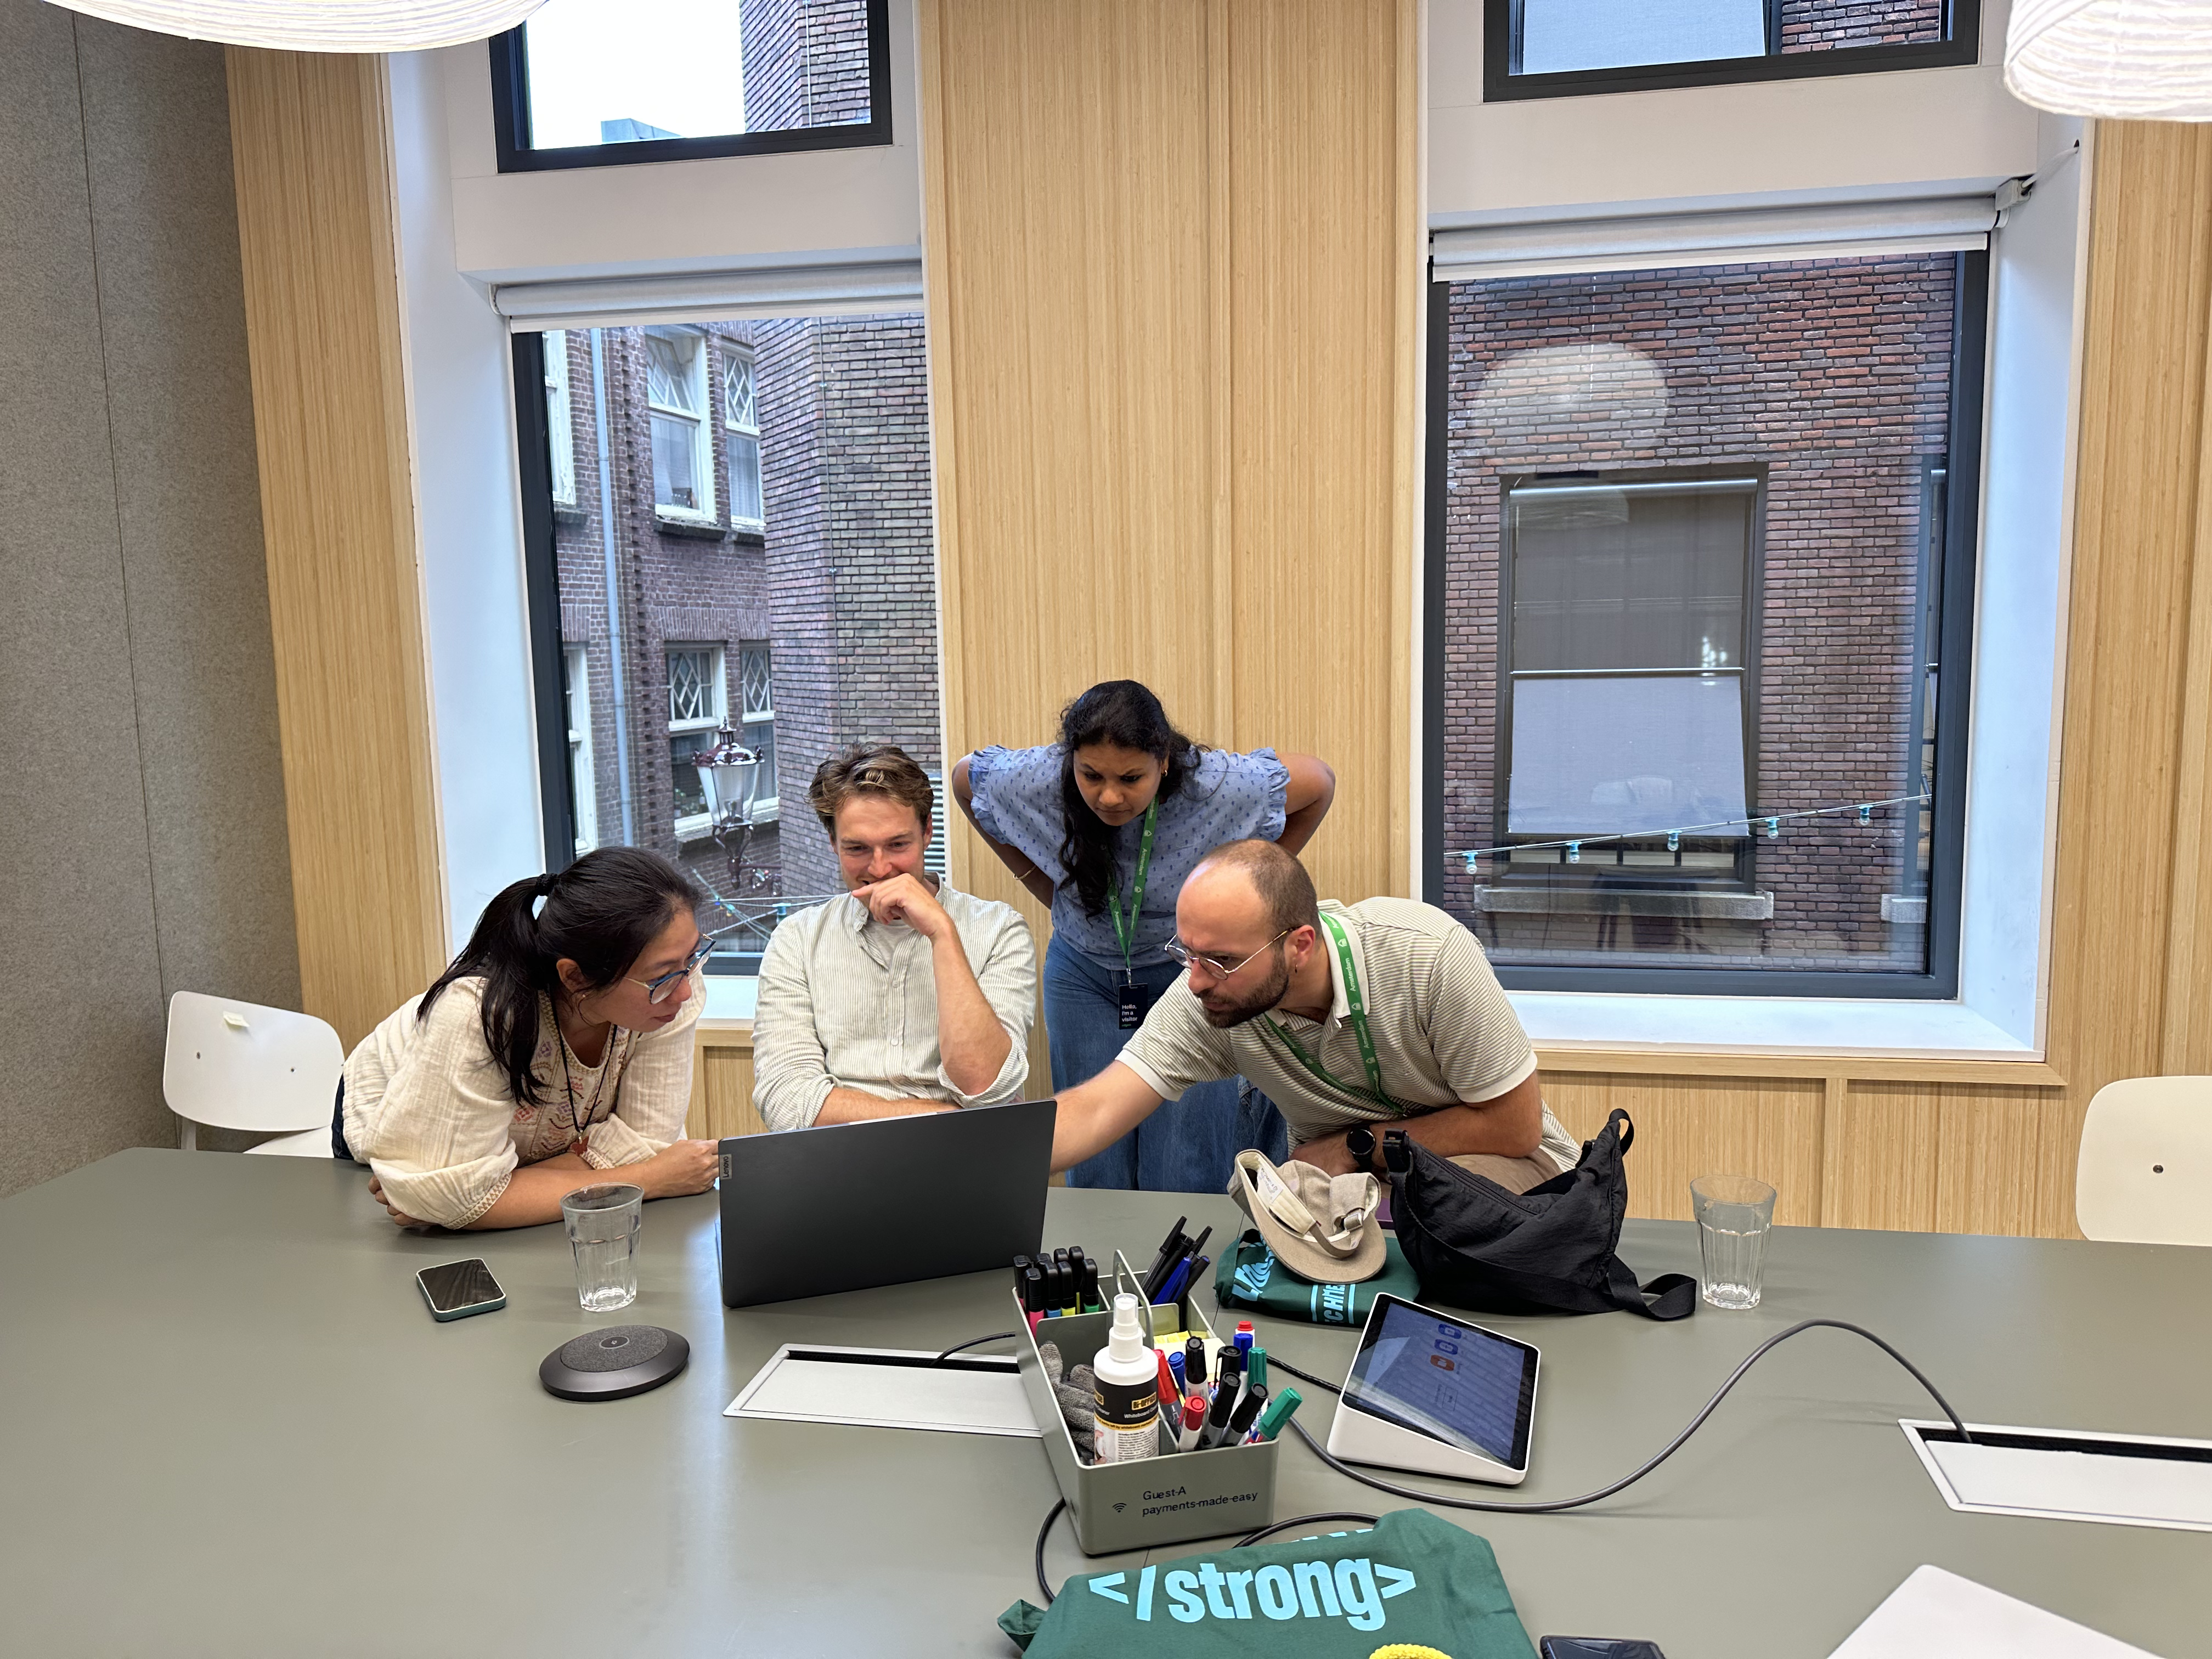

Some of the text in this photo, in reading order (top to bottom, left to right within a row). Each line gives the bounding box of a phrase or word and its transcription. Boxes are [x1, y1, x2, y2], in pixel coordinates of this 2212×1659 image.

[1345, 957, 1357, 991] Amsterdam
[1358, 1020, 1370, 1048] Amsterdam
[1322, 1284, 1346, 1323] CHME
[1142, 1486, 1187, 1500] Guest-A
[1142, 1492, 1259, 1517] payments-made-easy
[1088, 1558, 1417, 1631] </strong>
